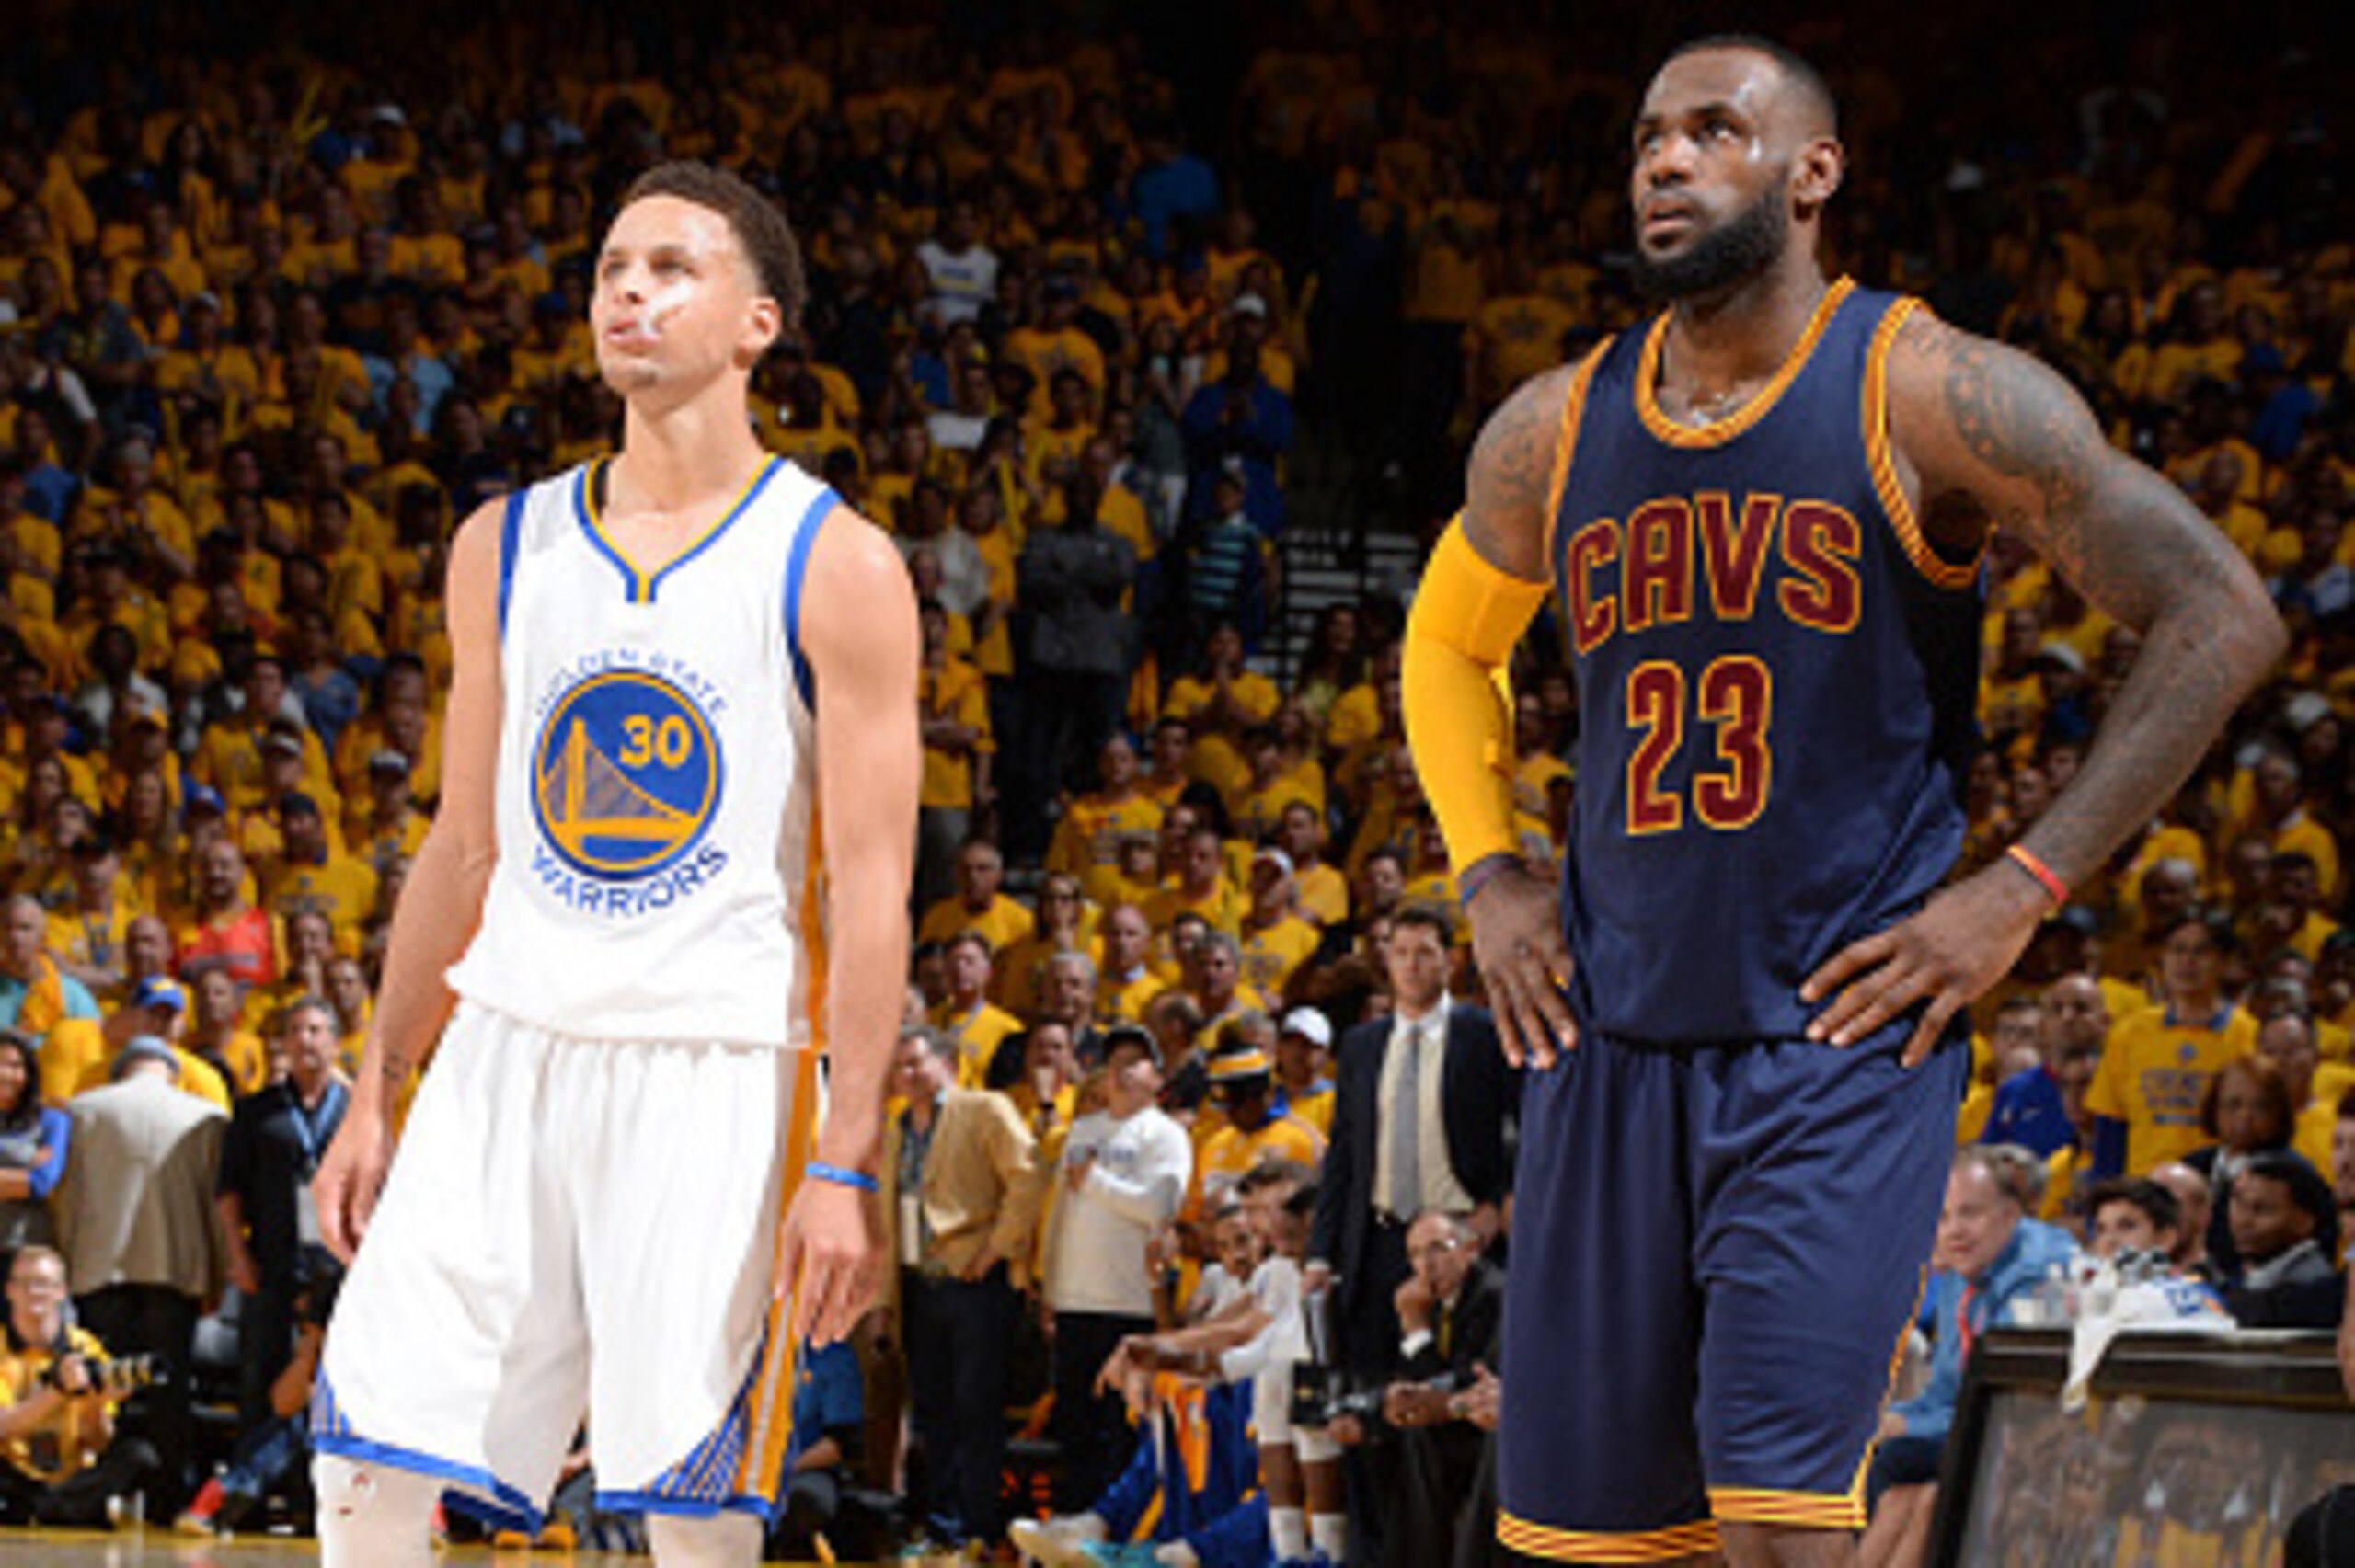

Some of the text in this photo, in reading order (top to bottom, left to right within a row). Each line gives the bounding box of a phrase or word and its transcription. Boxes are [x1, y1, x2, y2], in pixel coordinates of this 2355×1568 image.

[1568, 489, 1862, 655] CAVS
[619, 714, 692, 768] 30
[1626, 654, 1772, 836] 23
[531, 841, 729, 918] WARRIORS
